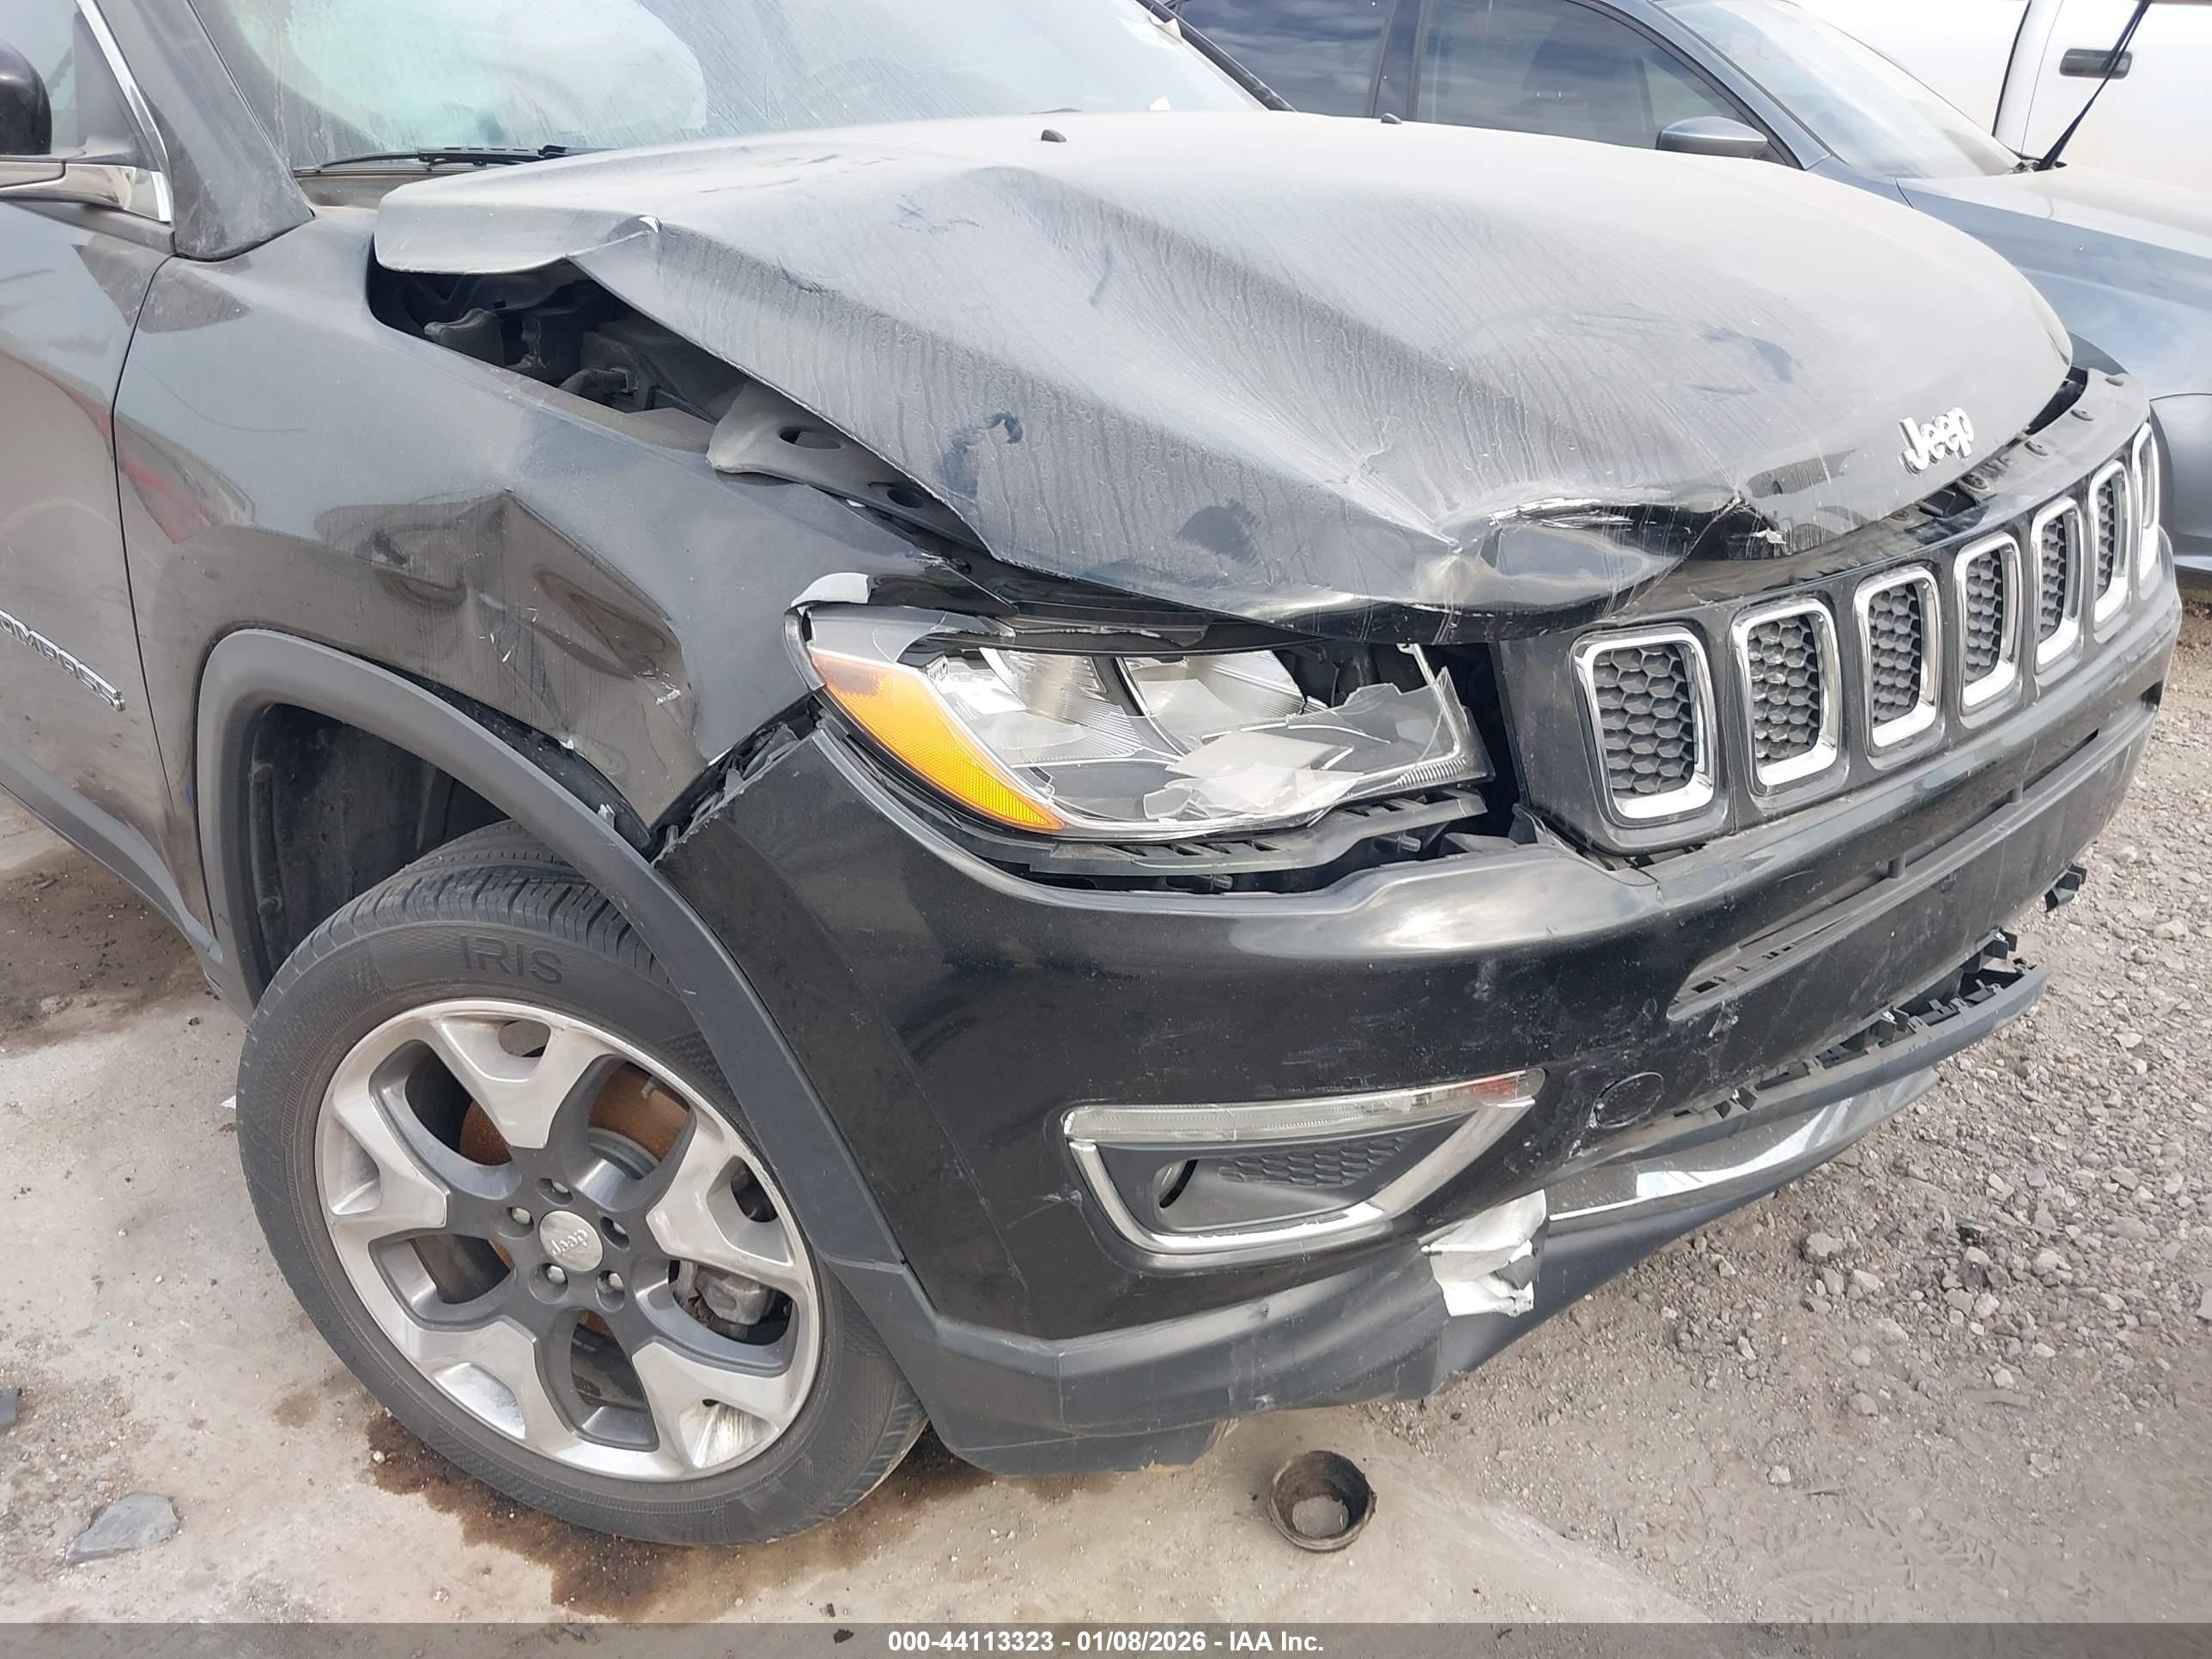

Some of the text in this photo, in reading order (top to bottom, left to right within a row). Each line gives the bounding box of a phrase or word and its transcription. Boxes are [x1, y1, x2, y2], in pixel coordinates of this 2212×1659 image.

[1899, 406, 1974, 474] Jeep
[0, 608, 126, 713] OMPASS
[459, 934, 563, 985] IRIS
[551, 1229, 588, 1255] Jeep
